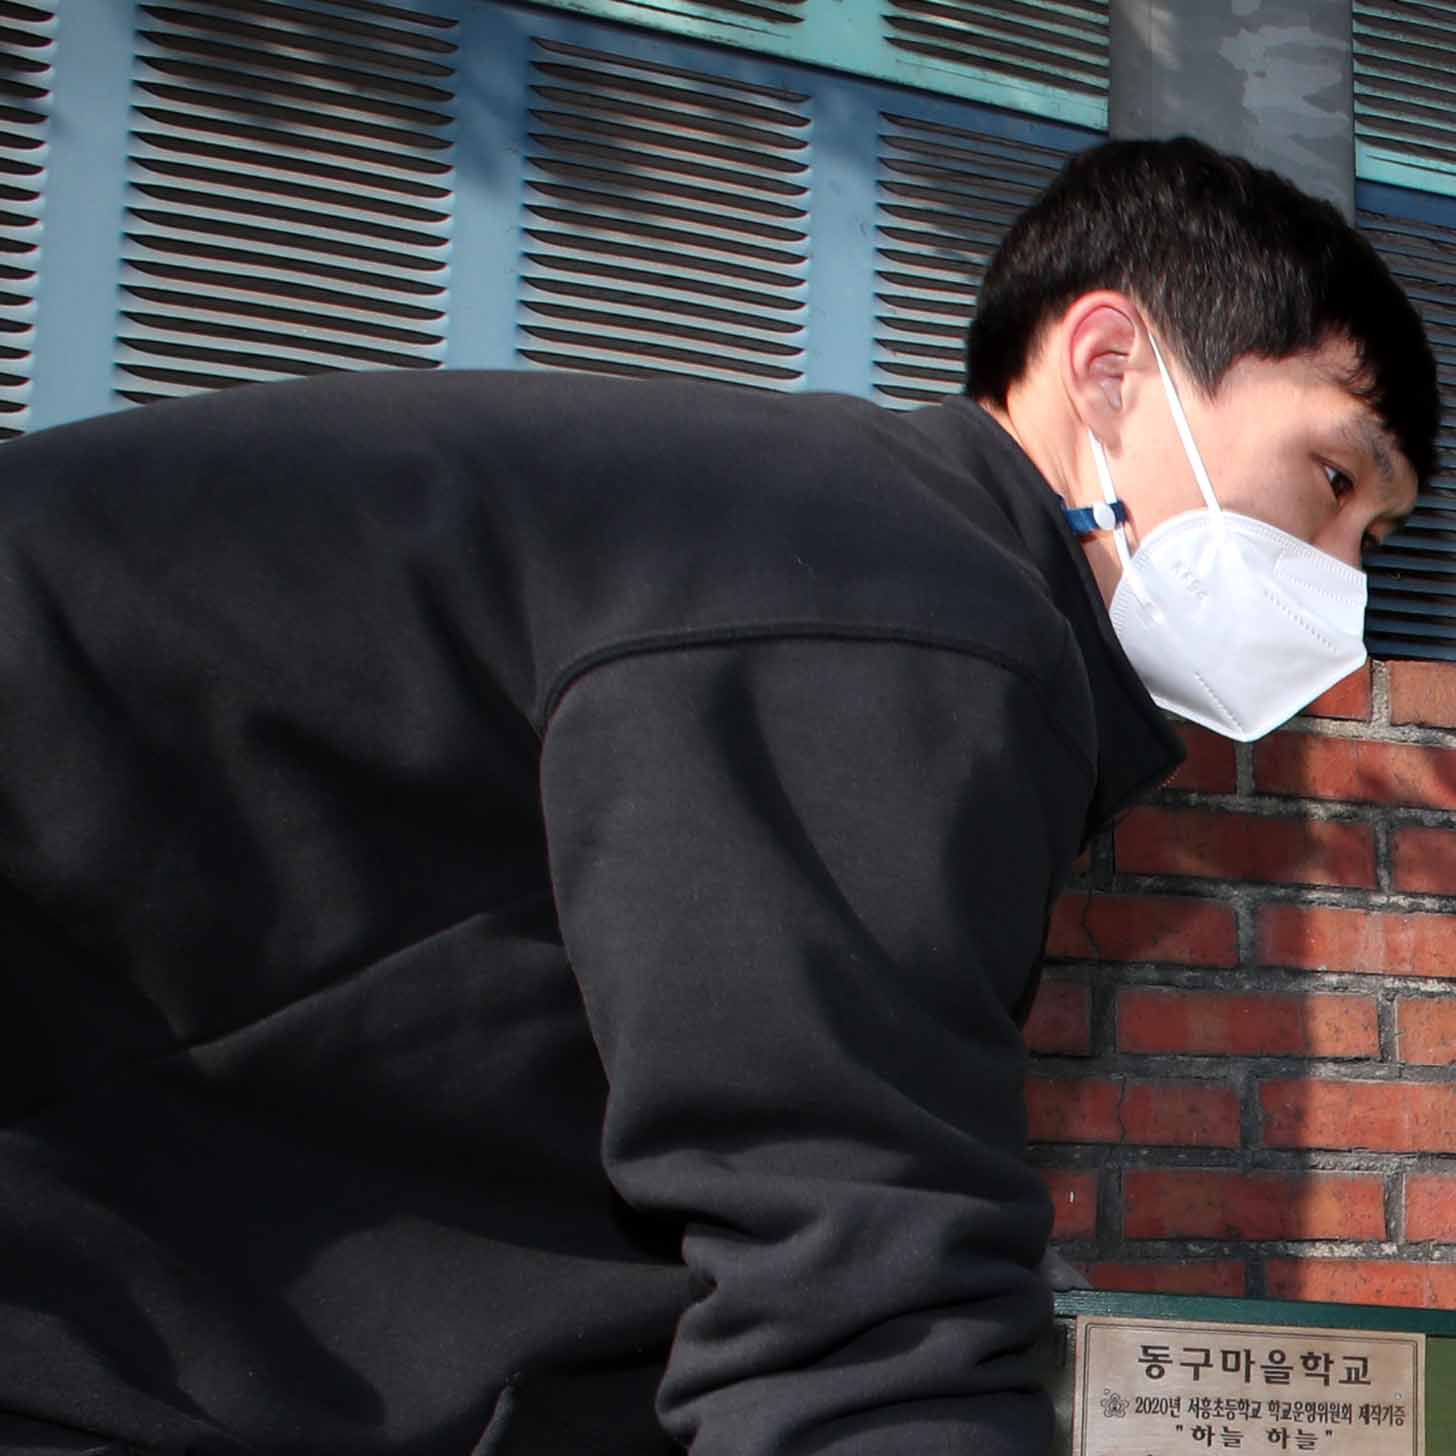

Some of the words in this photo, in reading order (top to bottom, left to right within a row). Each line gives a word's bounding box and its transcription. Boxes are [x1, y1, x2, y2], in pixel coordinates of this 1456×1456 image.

[1137, 1344, 1372, 1387] 동구마을학교
[1135, 1396, 1182, 1418] 2020년
[1187, 1397, 1262, 1420] 서흥초등학교
[1268, 1399, 1353, 1425] 학교운영위원회
[1358, 1402, 1407, 1427] 제작기증
